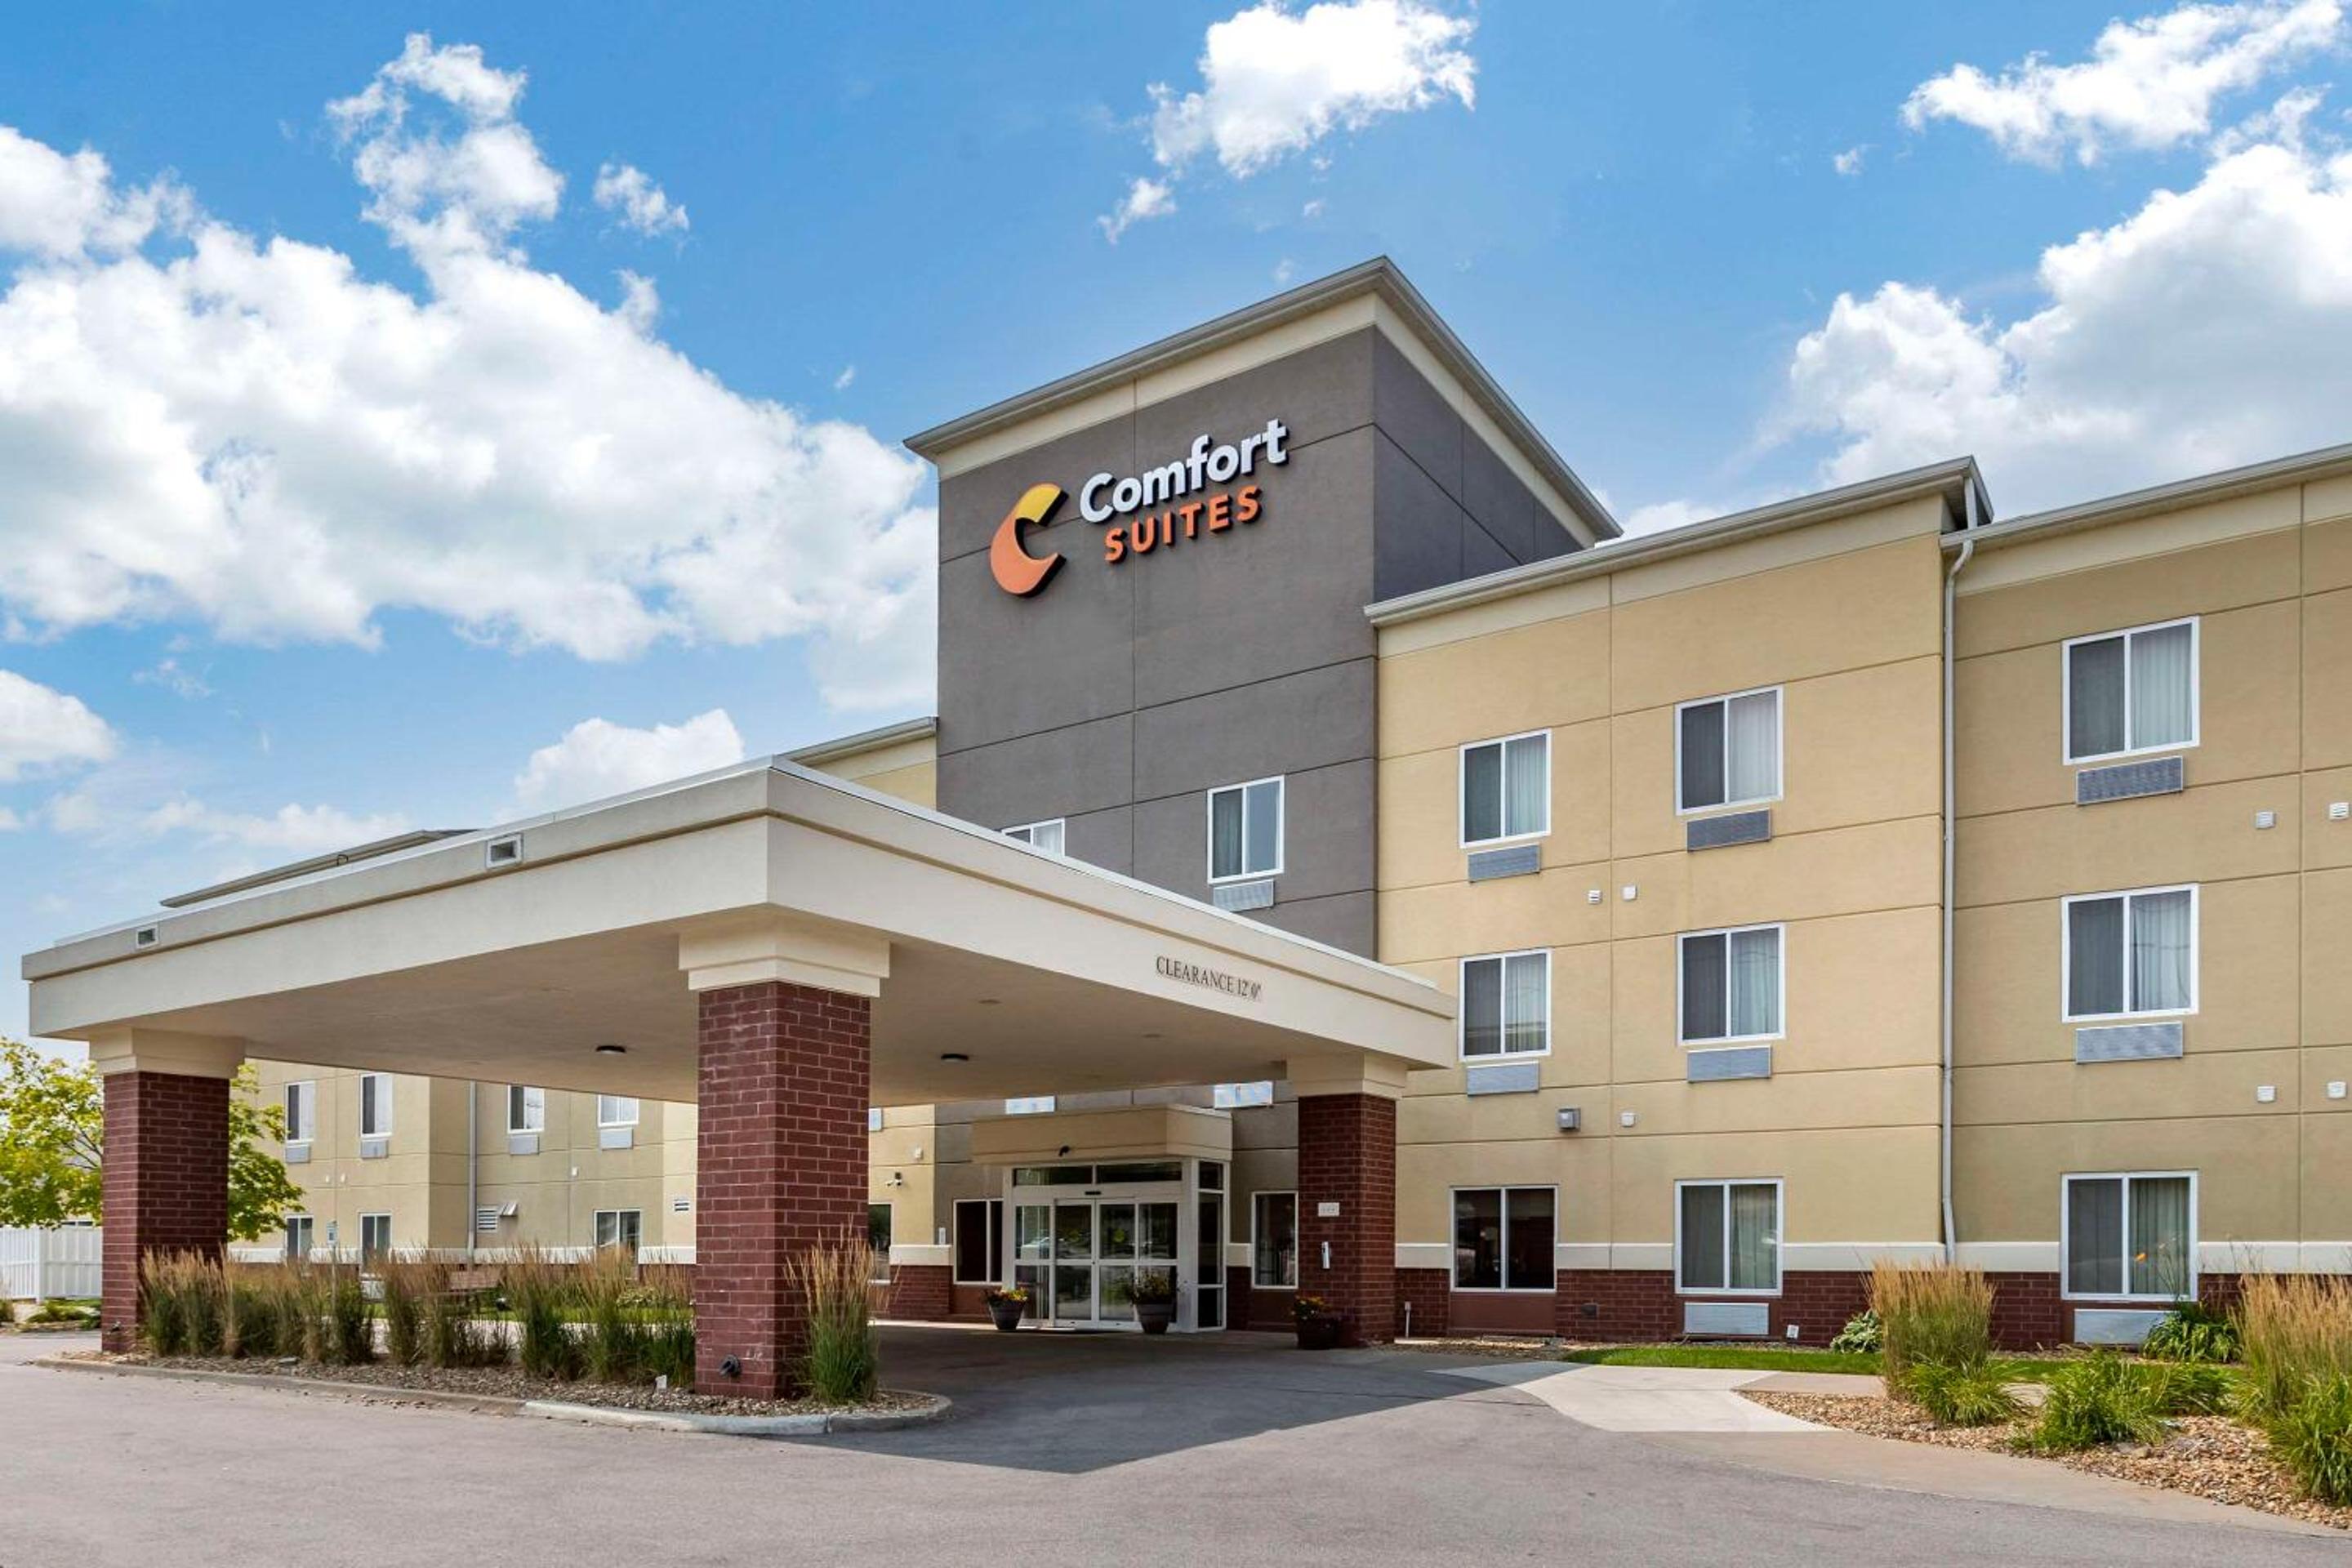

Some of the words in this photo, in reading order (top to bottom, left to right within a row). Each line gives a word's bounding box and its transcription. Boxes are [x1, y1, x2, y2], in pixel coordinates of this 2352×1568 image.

[1079, 418, 1288, 524] Comfort
[1104, 485, 1261, 564] SUITES
[1156, 955, 1234, 993] CLEARANCE
